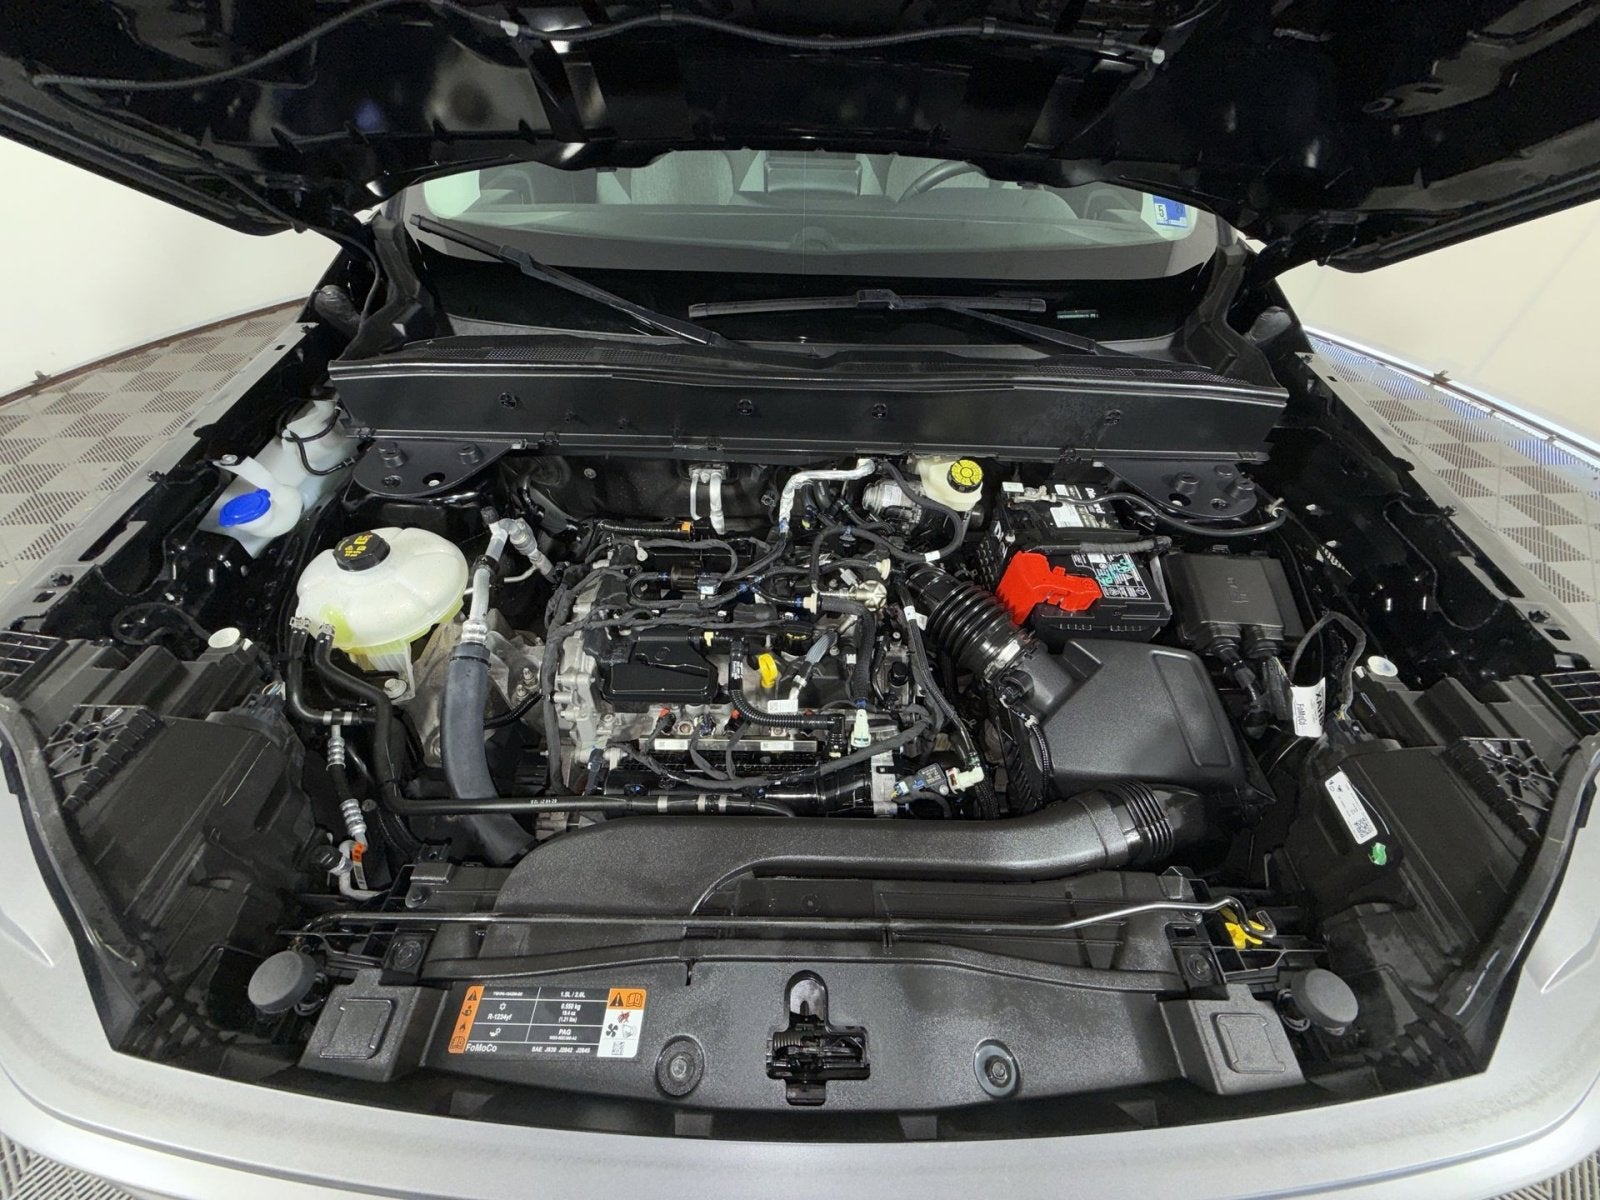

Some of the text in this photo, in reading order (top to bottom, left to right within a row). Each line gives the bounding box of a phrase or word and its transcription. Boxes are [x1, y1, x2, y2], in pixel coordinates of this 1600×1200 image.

[1158, 205, 1165, 217] 5
[487, 1013, 512, 1021] R-1234yf
[465, 1043, 497, 1052] FoMoCo
